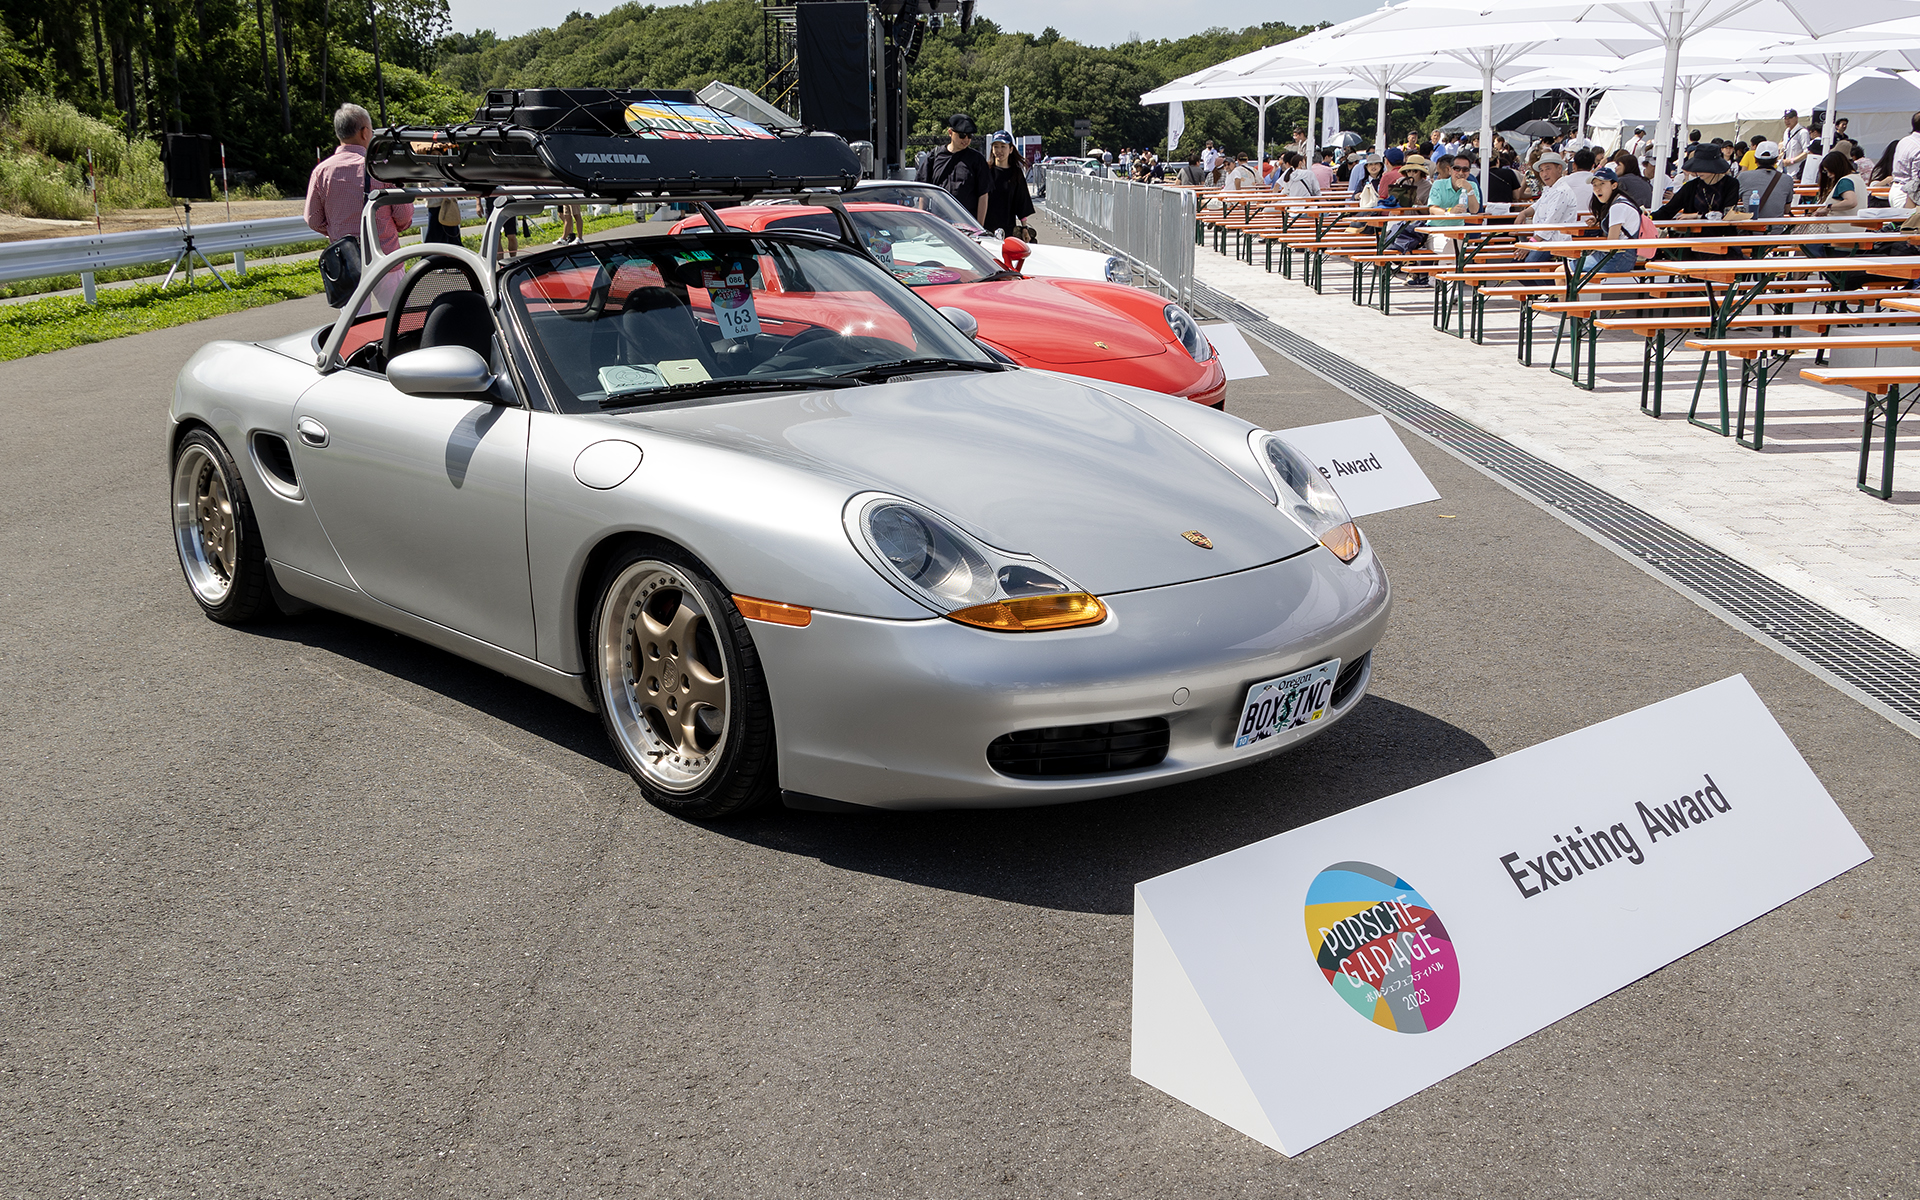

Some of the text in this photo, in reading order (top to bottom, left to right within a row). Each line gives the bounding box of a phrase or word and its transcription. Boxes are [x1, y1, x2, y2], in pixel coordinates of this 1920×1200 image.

[575, 153, 651, 164] YAKIMA
[724, 308, 752, 327] 163
[1331, 452, 1383, 477] Award
[656, 542, 686, 559] HIFLY
[1278, 673, 1312, 691] Oregon
[1242, 679, 1331, 736] BOXSTNC
[1499, 773, 1732, 899] Exciting Award
[1318, 894, 1421, 957] PORSCHE
[1339, 924, 1441, 989] GARAGE
[1365, 961, 1444, 1003] ポルシェフェスティバル
[1402, 988, 1431, 1011] 2023
